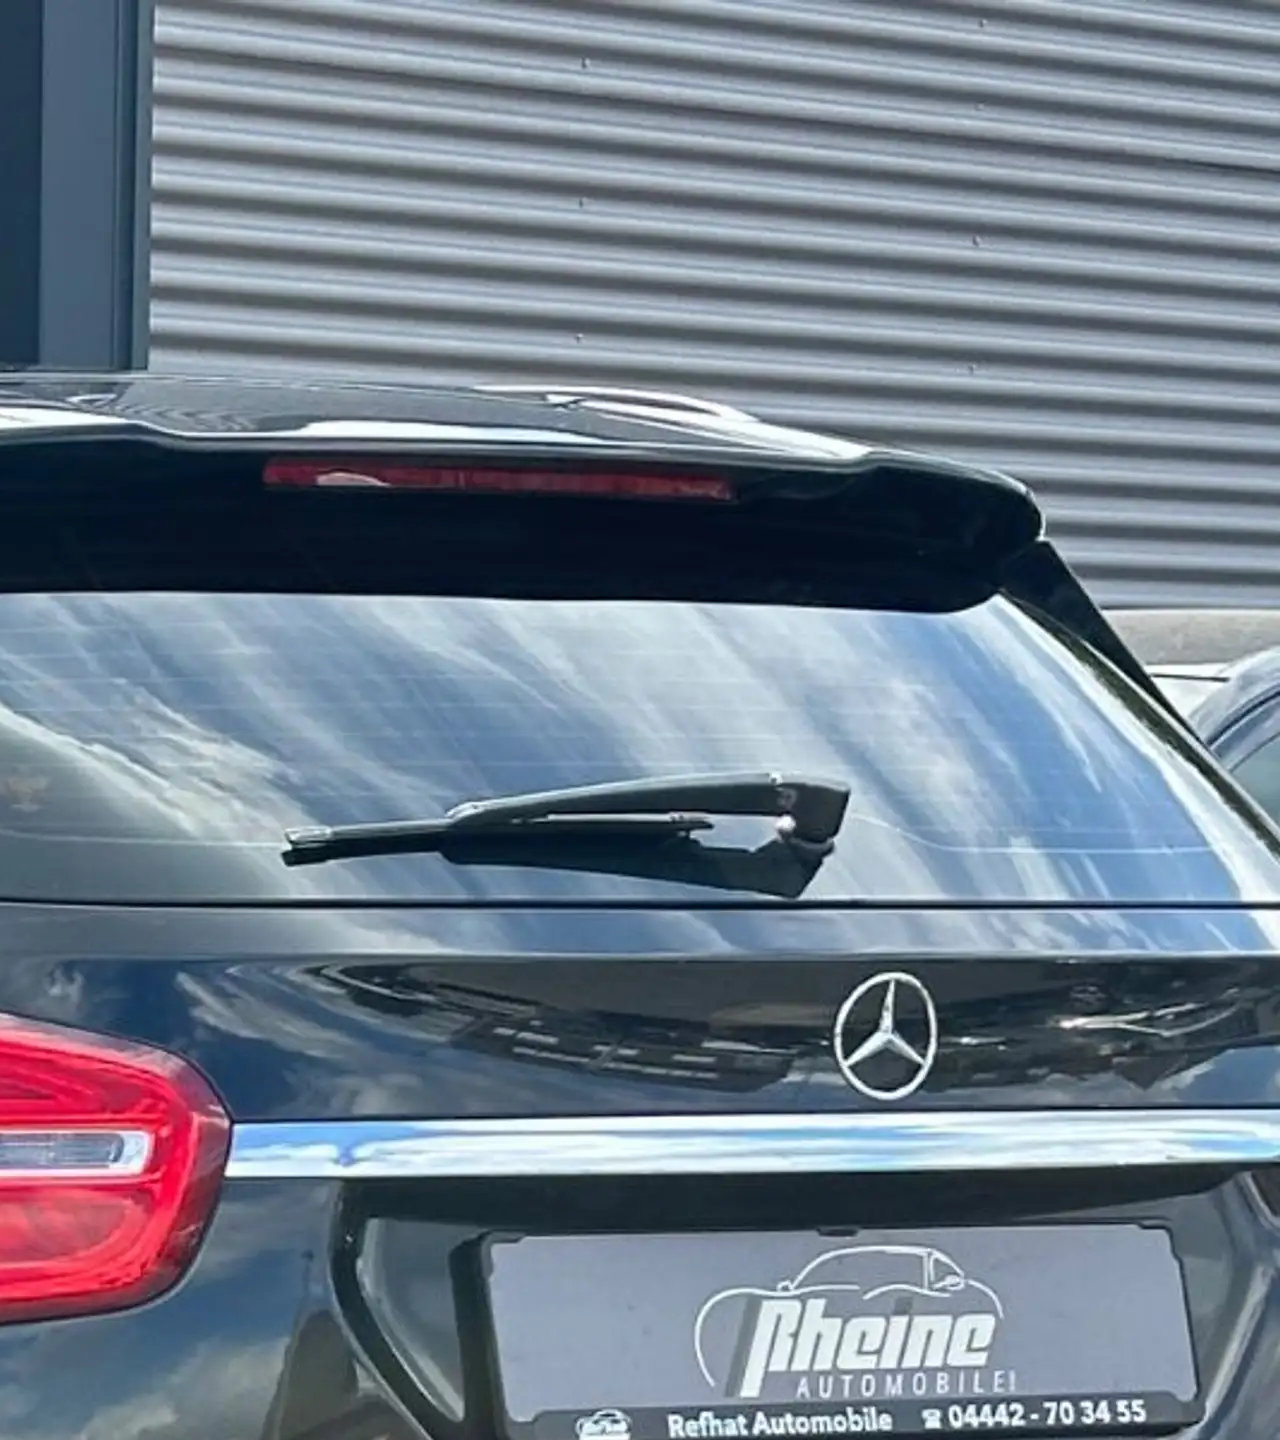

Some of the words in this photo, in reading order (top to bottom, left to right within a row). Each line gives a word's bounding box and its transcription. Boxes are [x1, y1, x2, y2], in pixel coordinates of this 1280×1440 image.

[739, 1297, 996, 1398] Rheine
[666, 1413, 746, 1439] Refhat
[752, 1406, 894, 1436] Automobile
[948, 1402, 1026, 1429] 04442
[1043, 1400, 1075, 1426] 70
[1080, 1399, 1111, 1425] 34
[1116, 1398, 1148, 1424] 55
